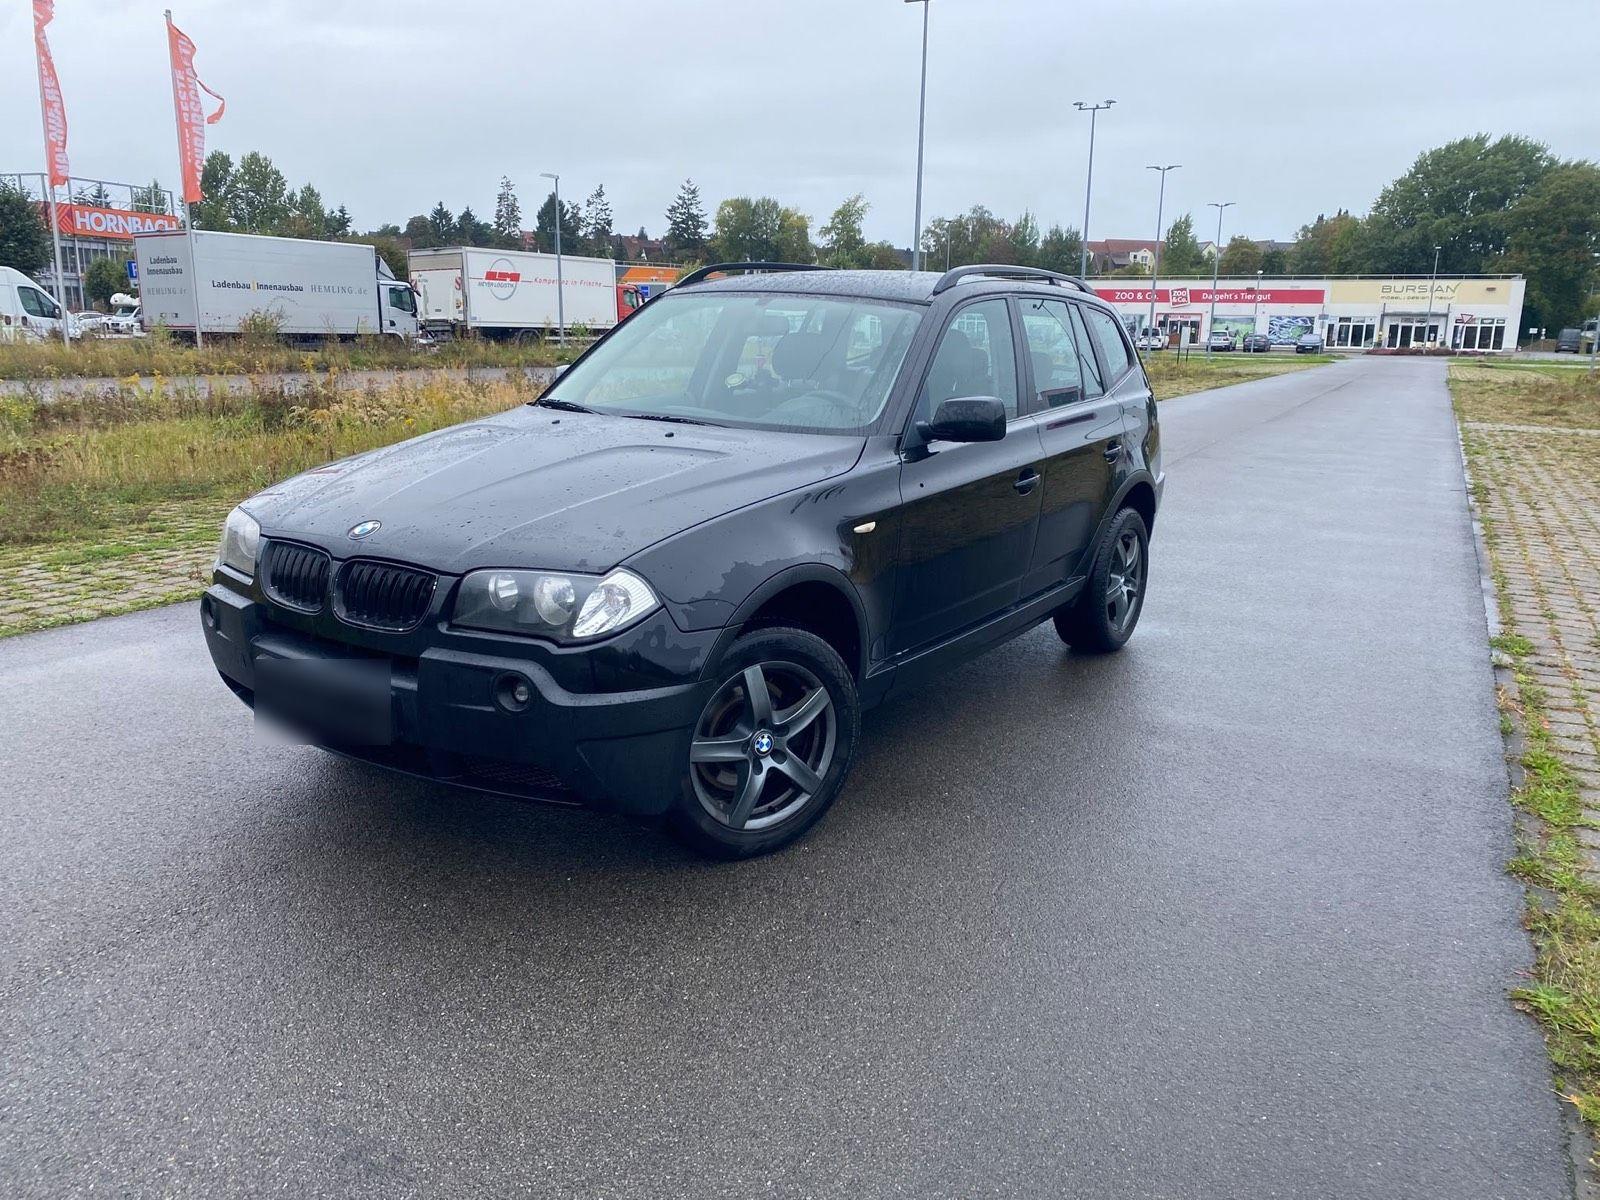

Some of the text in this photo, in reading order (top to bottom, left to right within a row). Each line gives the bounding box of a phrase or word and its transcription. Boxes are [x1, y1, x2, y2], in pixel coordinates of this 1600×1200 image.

[75, 210, 177, 234] HORNBACH
[150, 255, 178, 265] Ladenbau
[147, 266, 183, 275] Innenausbau
[534, 277, 569, 286] Kompetnz
[211, 280, 369, 295] Ladenbau Innenausbau HEMLING.de
[1381, 281, 1462, 294] BURSIAN
[1115, 291, 1135, 300] ZOO
[1137, 292, 1144, 300] &
[1202, 292, 1213, 300] Da
[1240, 292, 1256, 300] Tier
[1257, 293, 1272, 302] gut
